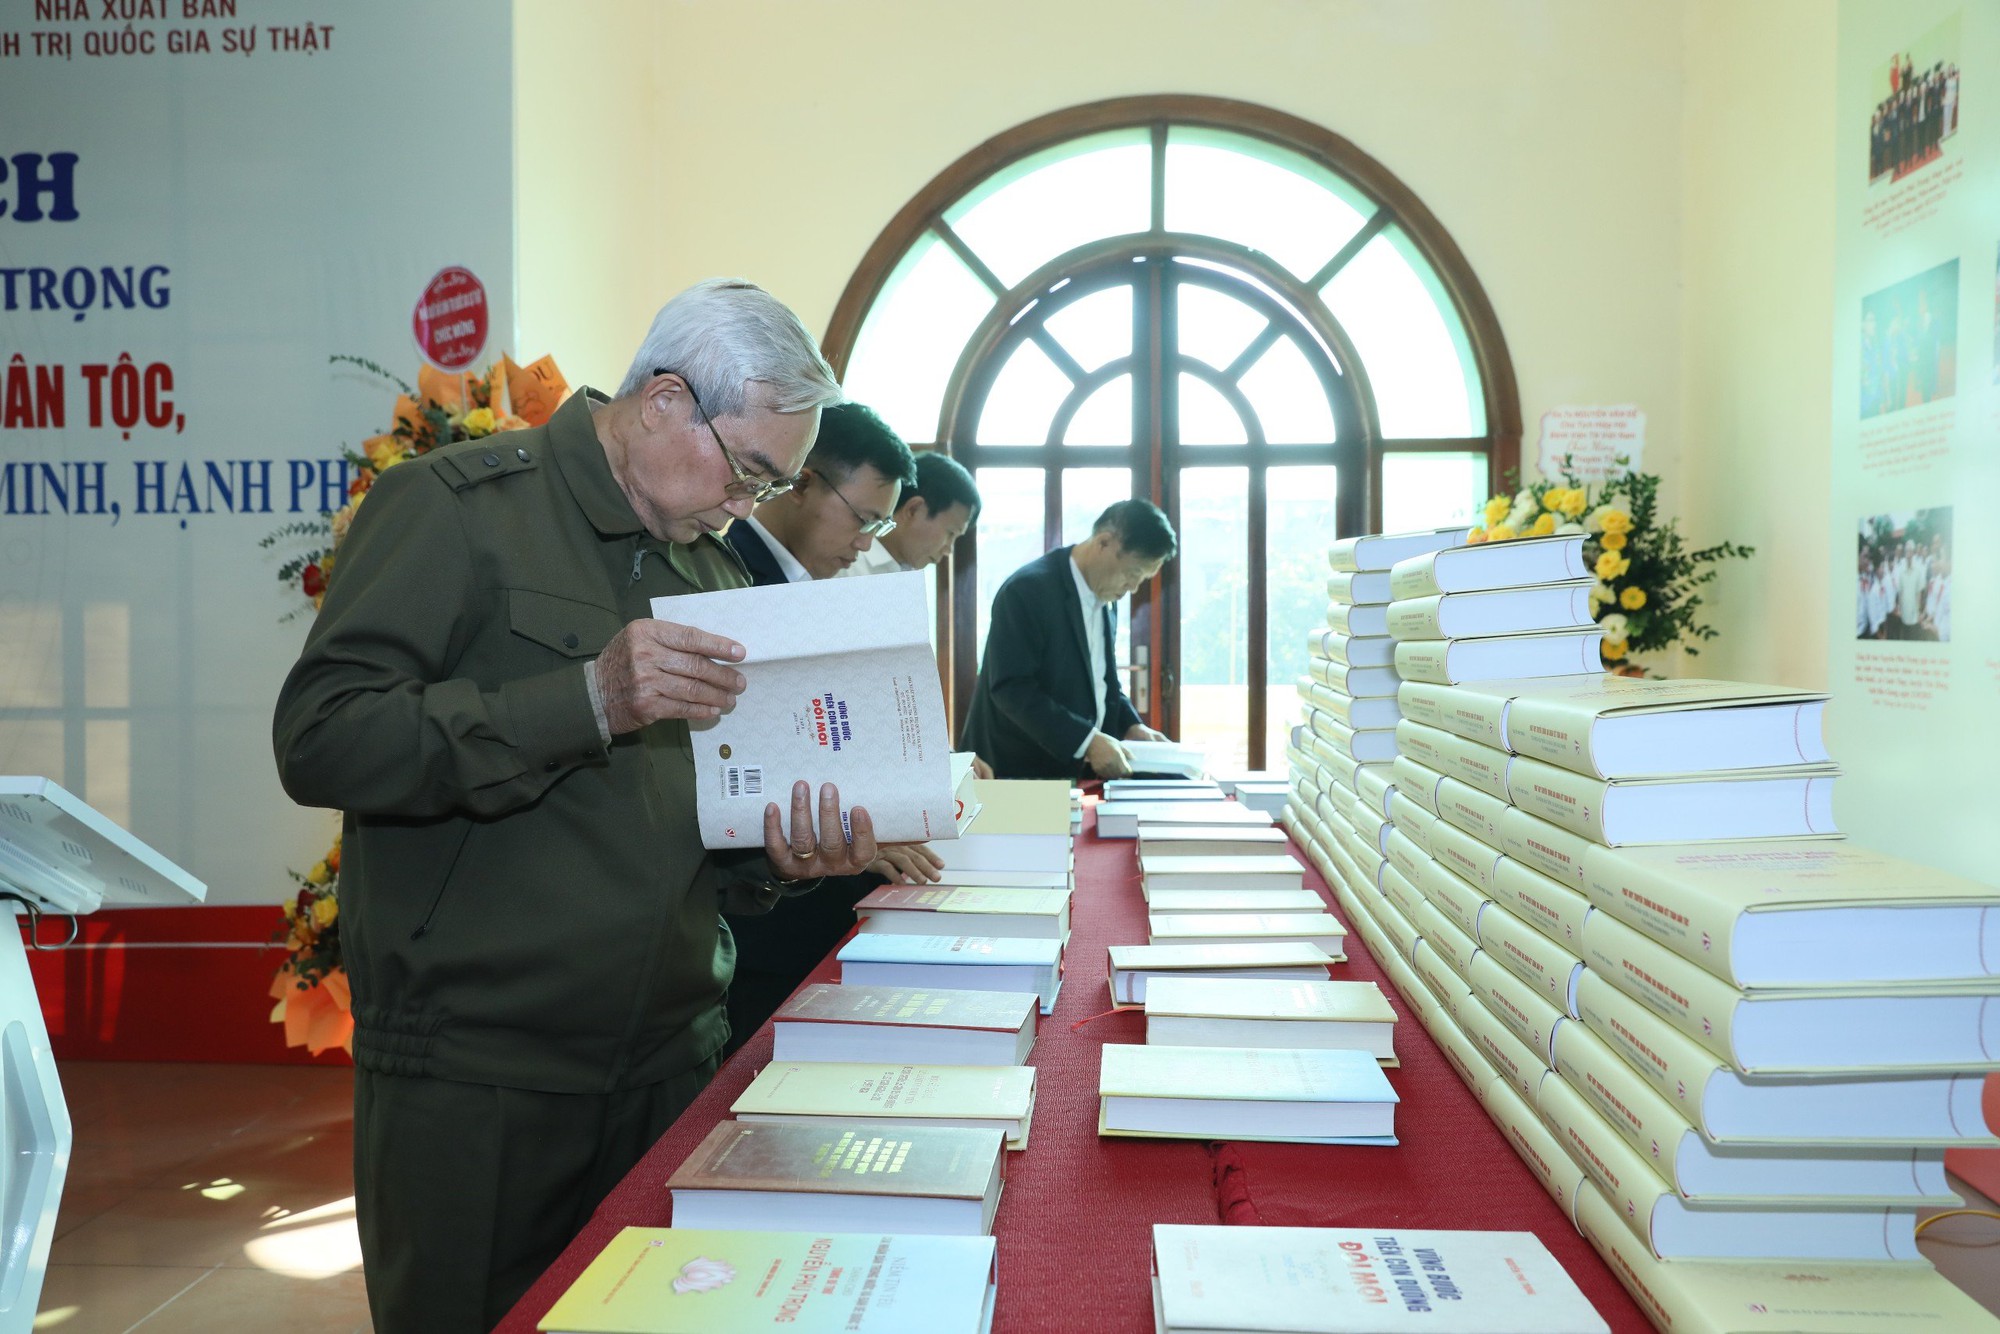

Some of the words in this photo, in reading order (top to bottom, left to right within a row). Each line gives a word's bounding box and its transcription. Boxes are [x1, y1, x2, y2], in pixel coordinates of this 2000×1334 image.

[31, 32, 71, 60] TRỊ
[84, 24, 155, 56] QUỐC
[167, 29, 210, 54] GIA
[222, 26, 256, 58] SỰ
[267, 22, 334, 55] THẬT
[0, 265, 170, 322] TRỌNG
[0, 353, 65, 429] ÂN
[81, 352, 185, 440] TỘC,
[134, 459, 274, 530] HẠNH
[286, 459, 358, 513] PH
[828, 711, 837, 725] CON
[1373, 1237, 1404, 1256] TRÊN
[1384, 1258, 1414, 1276] CON
